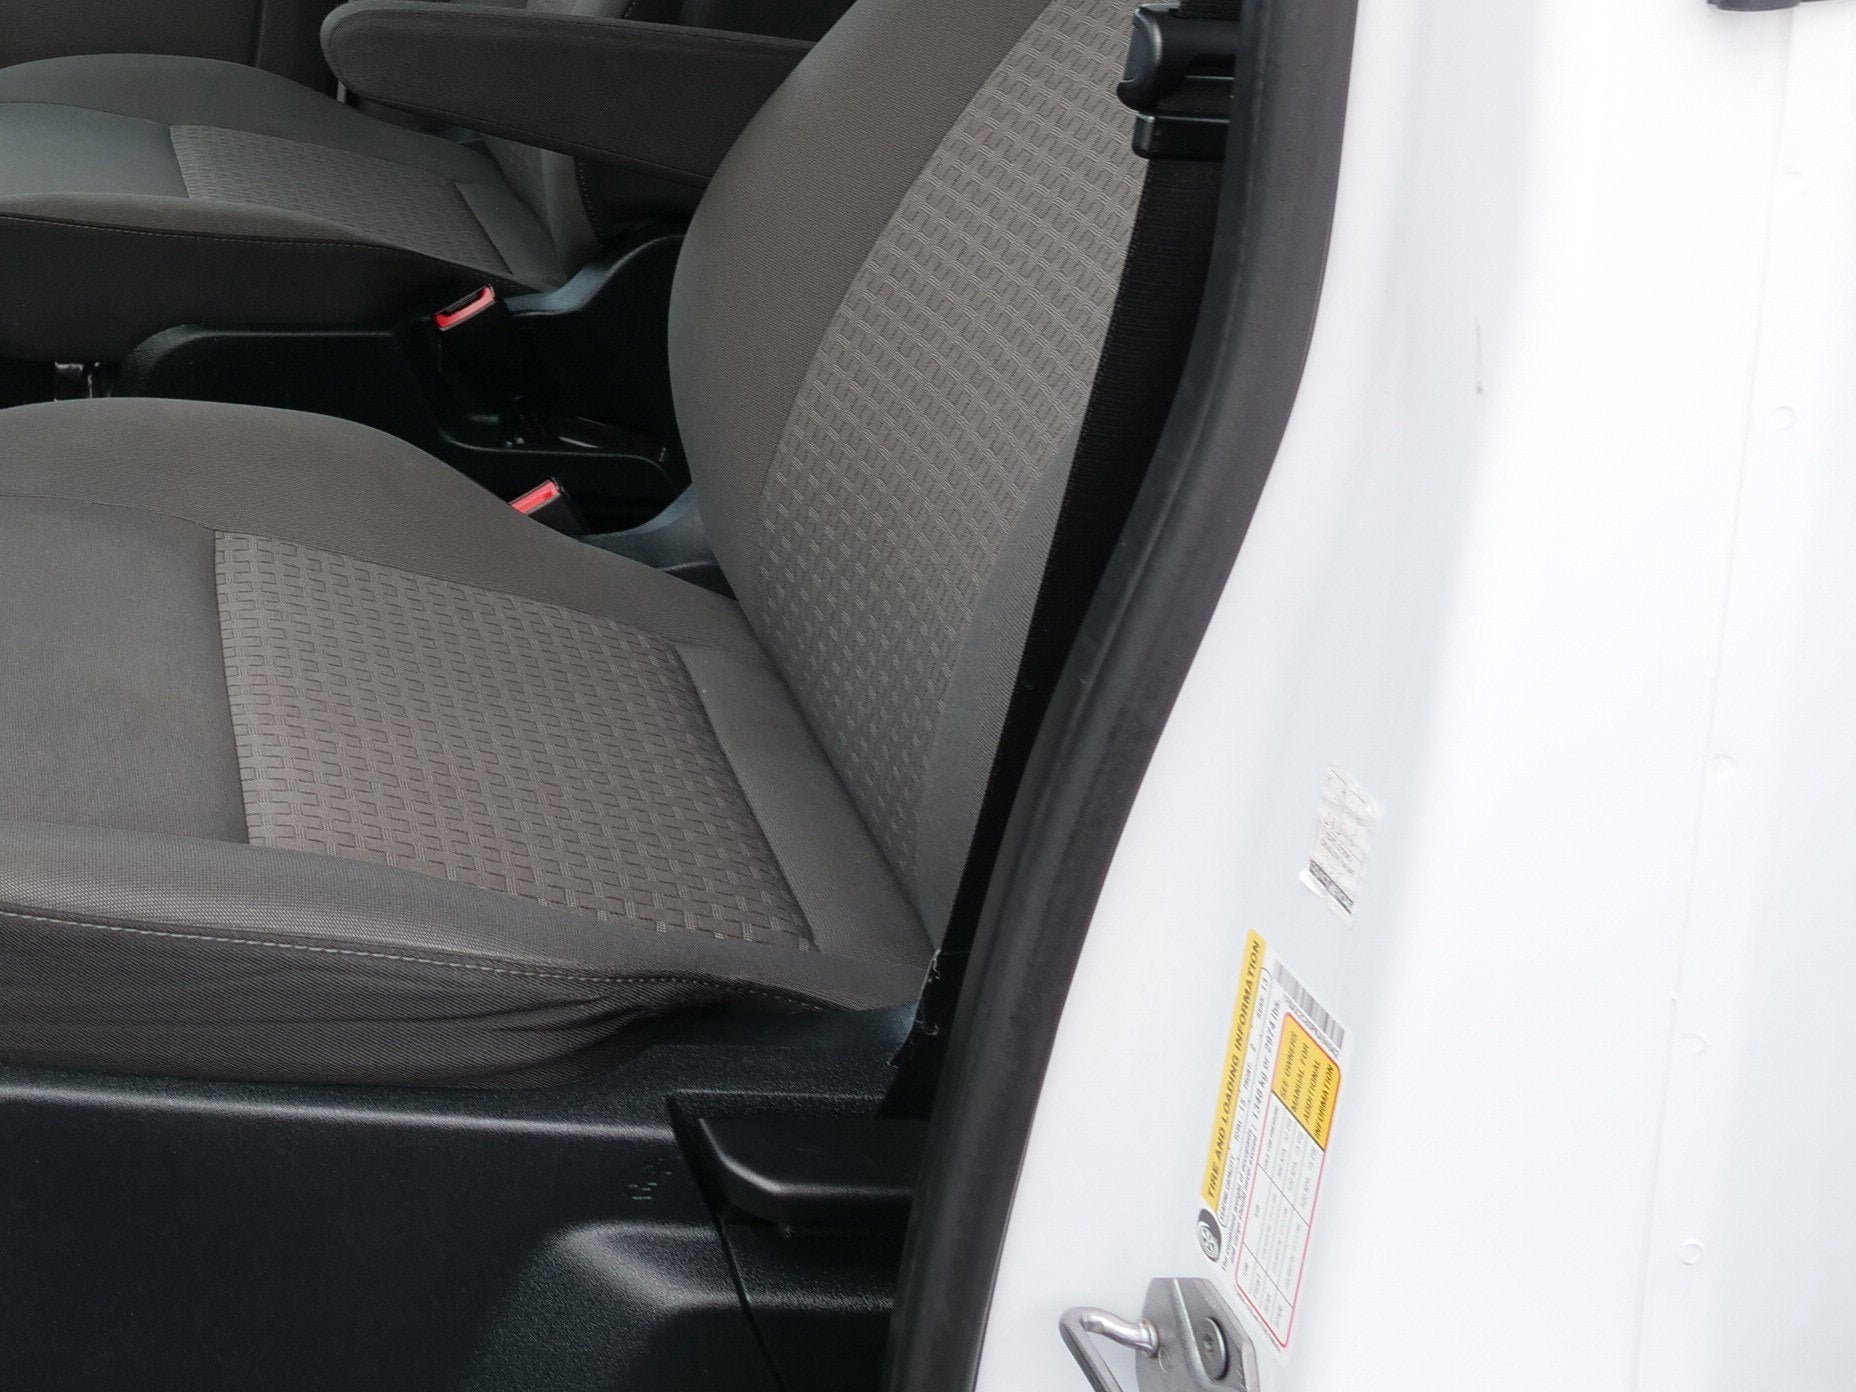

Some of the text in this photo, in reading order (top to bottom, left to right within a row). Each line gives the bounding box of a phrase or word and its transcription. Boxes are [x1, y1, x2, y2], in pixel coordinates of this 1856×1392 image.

[1206, 939, 1260, 1200] TIRE AND LOADING INFORMATION
[1279, 1030, 1298, 1099] SEE OWNERS
[1289, 1042, 1309, 1112] MANUAL FOR
[1302, 1058, 1321, 1122] ADDITIONAL
[1312, 1062, 1334, 1139] INFORMATION
